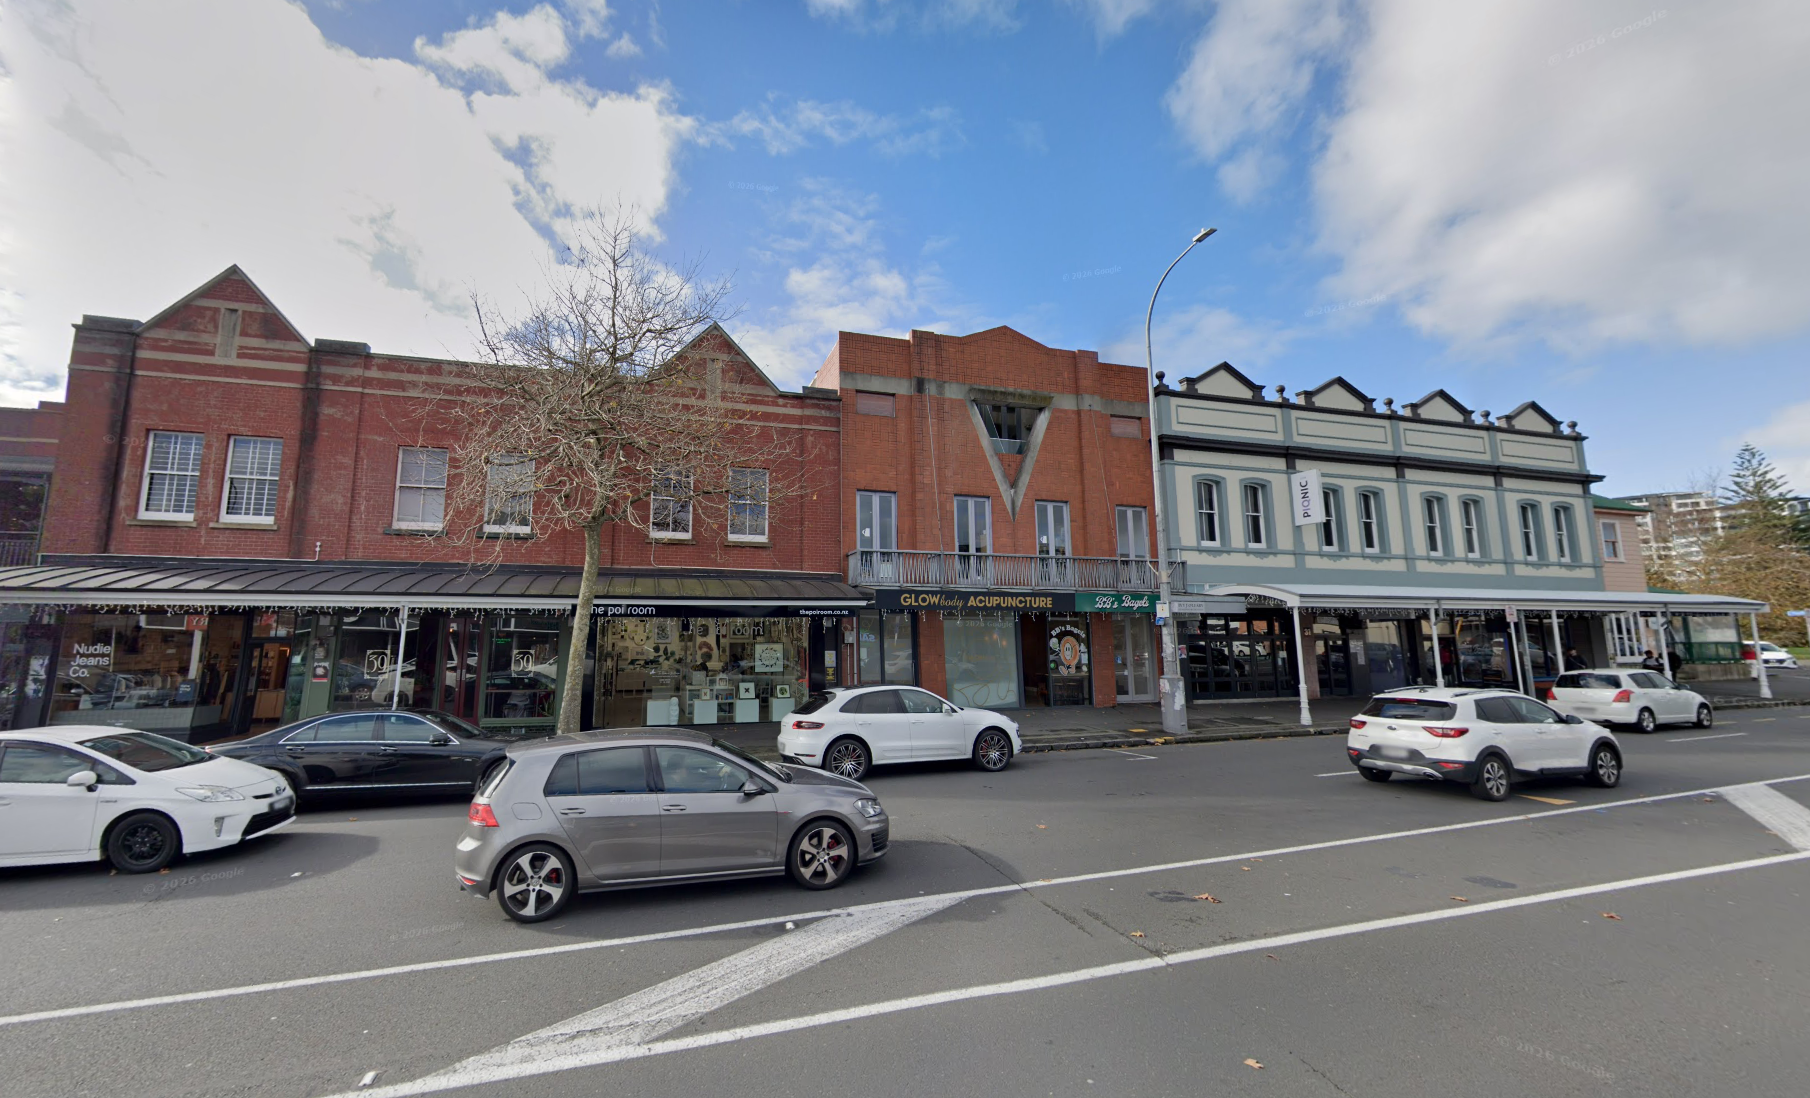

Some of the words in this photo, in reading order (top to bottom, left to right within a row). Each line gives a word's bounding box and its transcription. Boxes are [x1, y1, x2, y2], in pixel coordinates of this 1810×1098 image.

[1300, 480, 1312, 518] PIQNIC
[967, 596, 1053, 608] ACUPUNCTURE
[1094, 595, 1118, 609] BB's
[1121, 594, 1150, 610] Bagels
[590, 604, 604, 615] he
[607, 604, 625, 617] poi
[627, 606, 656, 615] room
[799, 608, 849, 616] thepoiroom.co.nz
[1050, 625, 1066, 636] BB's
[1065, 624, 1086, 639] Bagels
[73, 643, 112, 654] Nudie
[70, 654, 110, 666] Jeans
[368, 654, 388, 673] 39
[514, 654, 533, 672] 39
[69, 666, 90, 678] Co.
